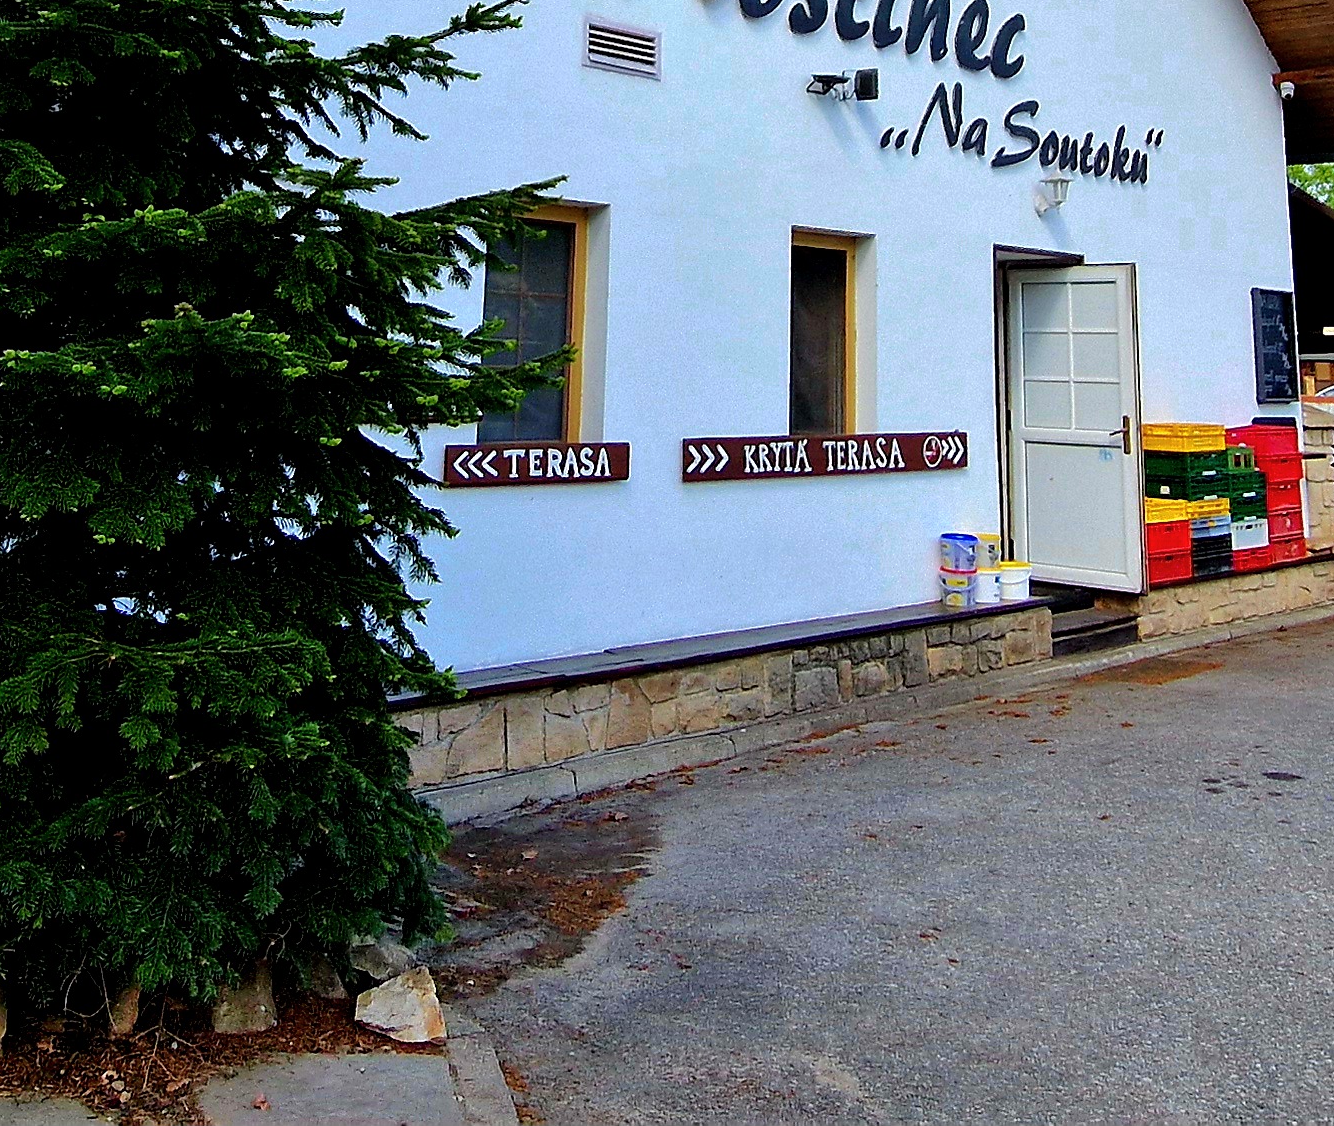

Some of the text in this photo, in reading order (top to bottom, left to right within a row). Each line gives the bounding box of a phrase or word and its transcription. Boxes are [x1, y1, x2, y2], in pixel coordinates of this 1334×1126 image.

[503, 448, 612, 479] TERASA
[743, 438, 906, 473] KRYTÁ TERASA
